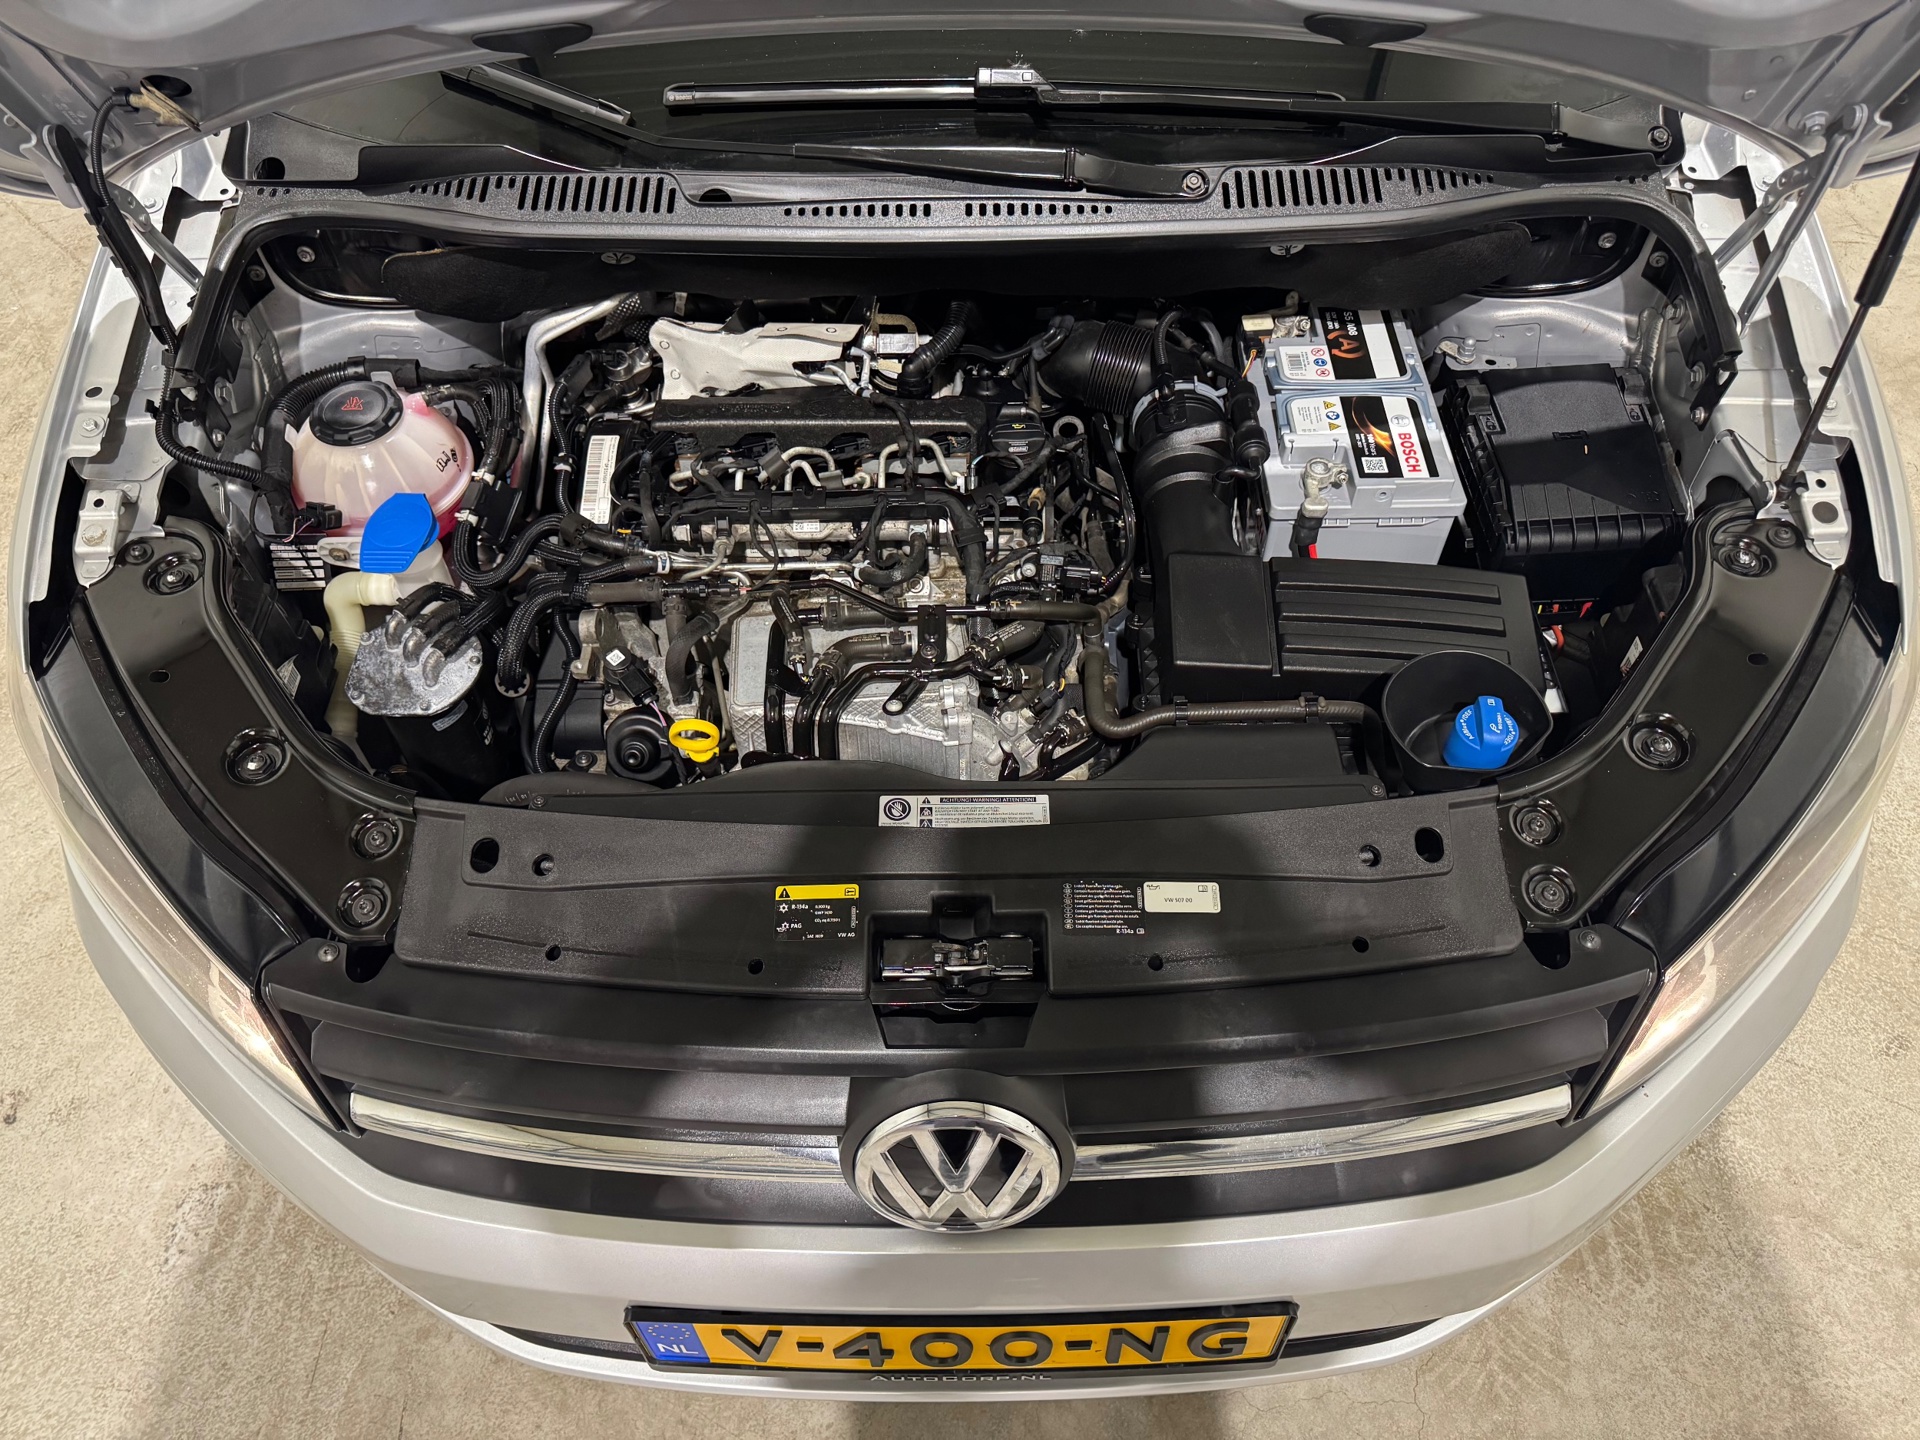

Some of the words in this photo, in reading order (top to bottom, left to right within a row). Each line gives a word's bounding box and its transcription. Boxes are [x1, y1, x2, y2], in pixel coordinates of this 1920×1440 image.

[1398, 432, 1422, 473] BOSCH
[656, 1343, 699, 1355] NL
[720, 1320, 1251, 1367] V-400-NG
